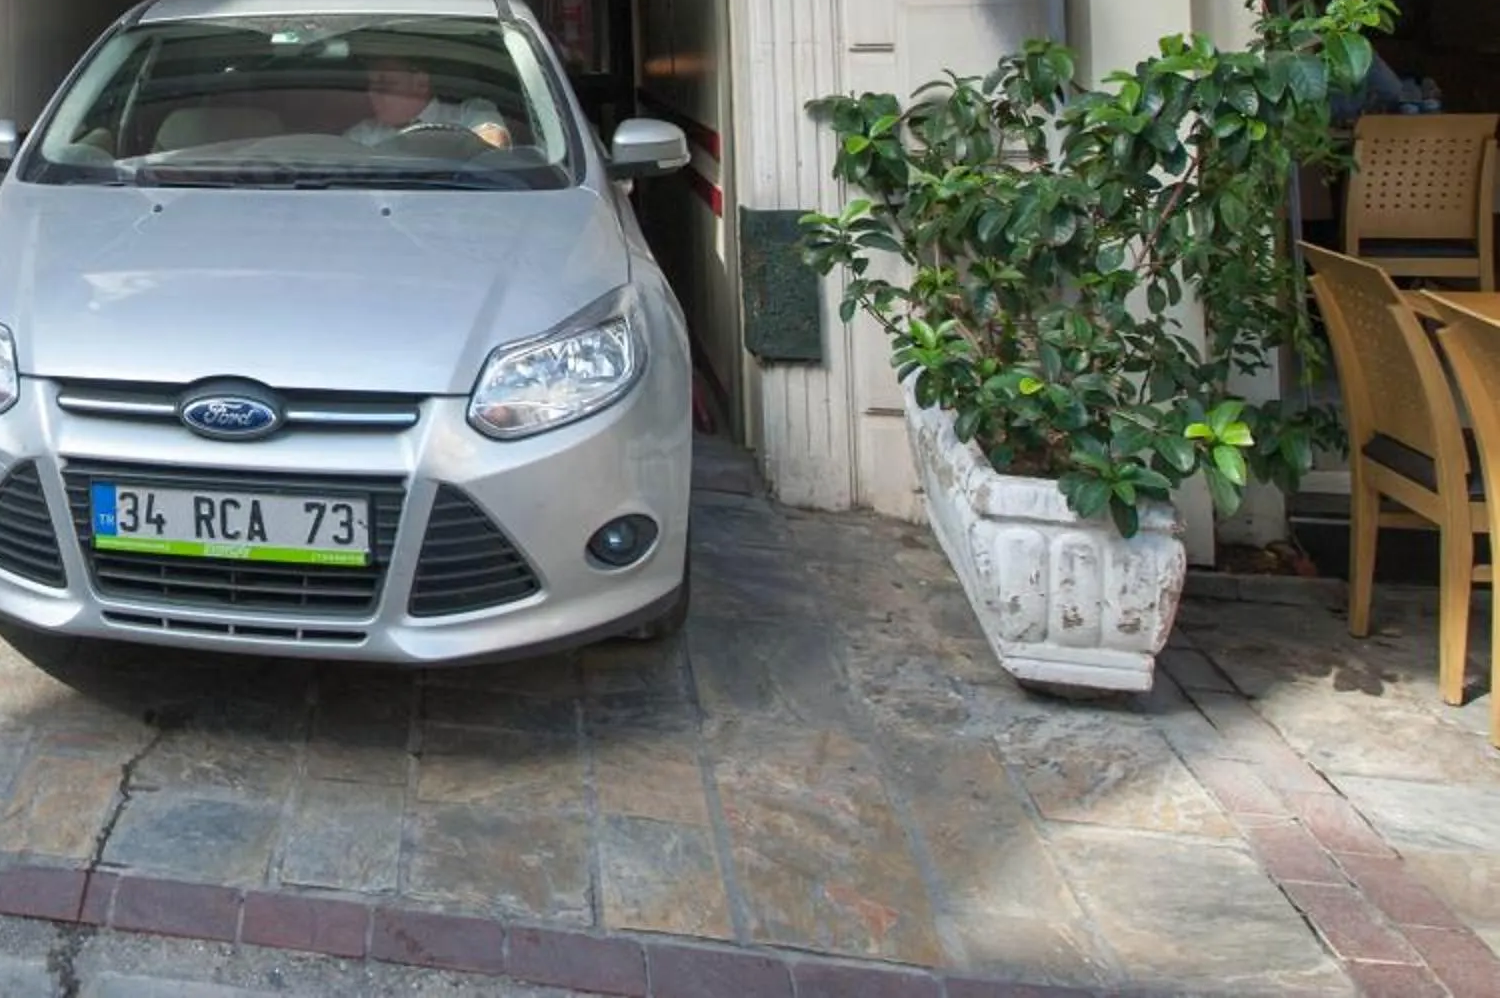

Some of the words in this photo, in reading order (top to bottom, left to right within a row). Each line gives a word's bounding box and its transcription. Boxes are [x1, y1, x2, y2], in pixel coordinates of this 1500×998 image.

[203, 402, 255, 427] Ford
[119, 491, 167, 535] 34
[193, 495, 268, 543] RCA
[304, 502, 355, 545] 73
